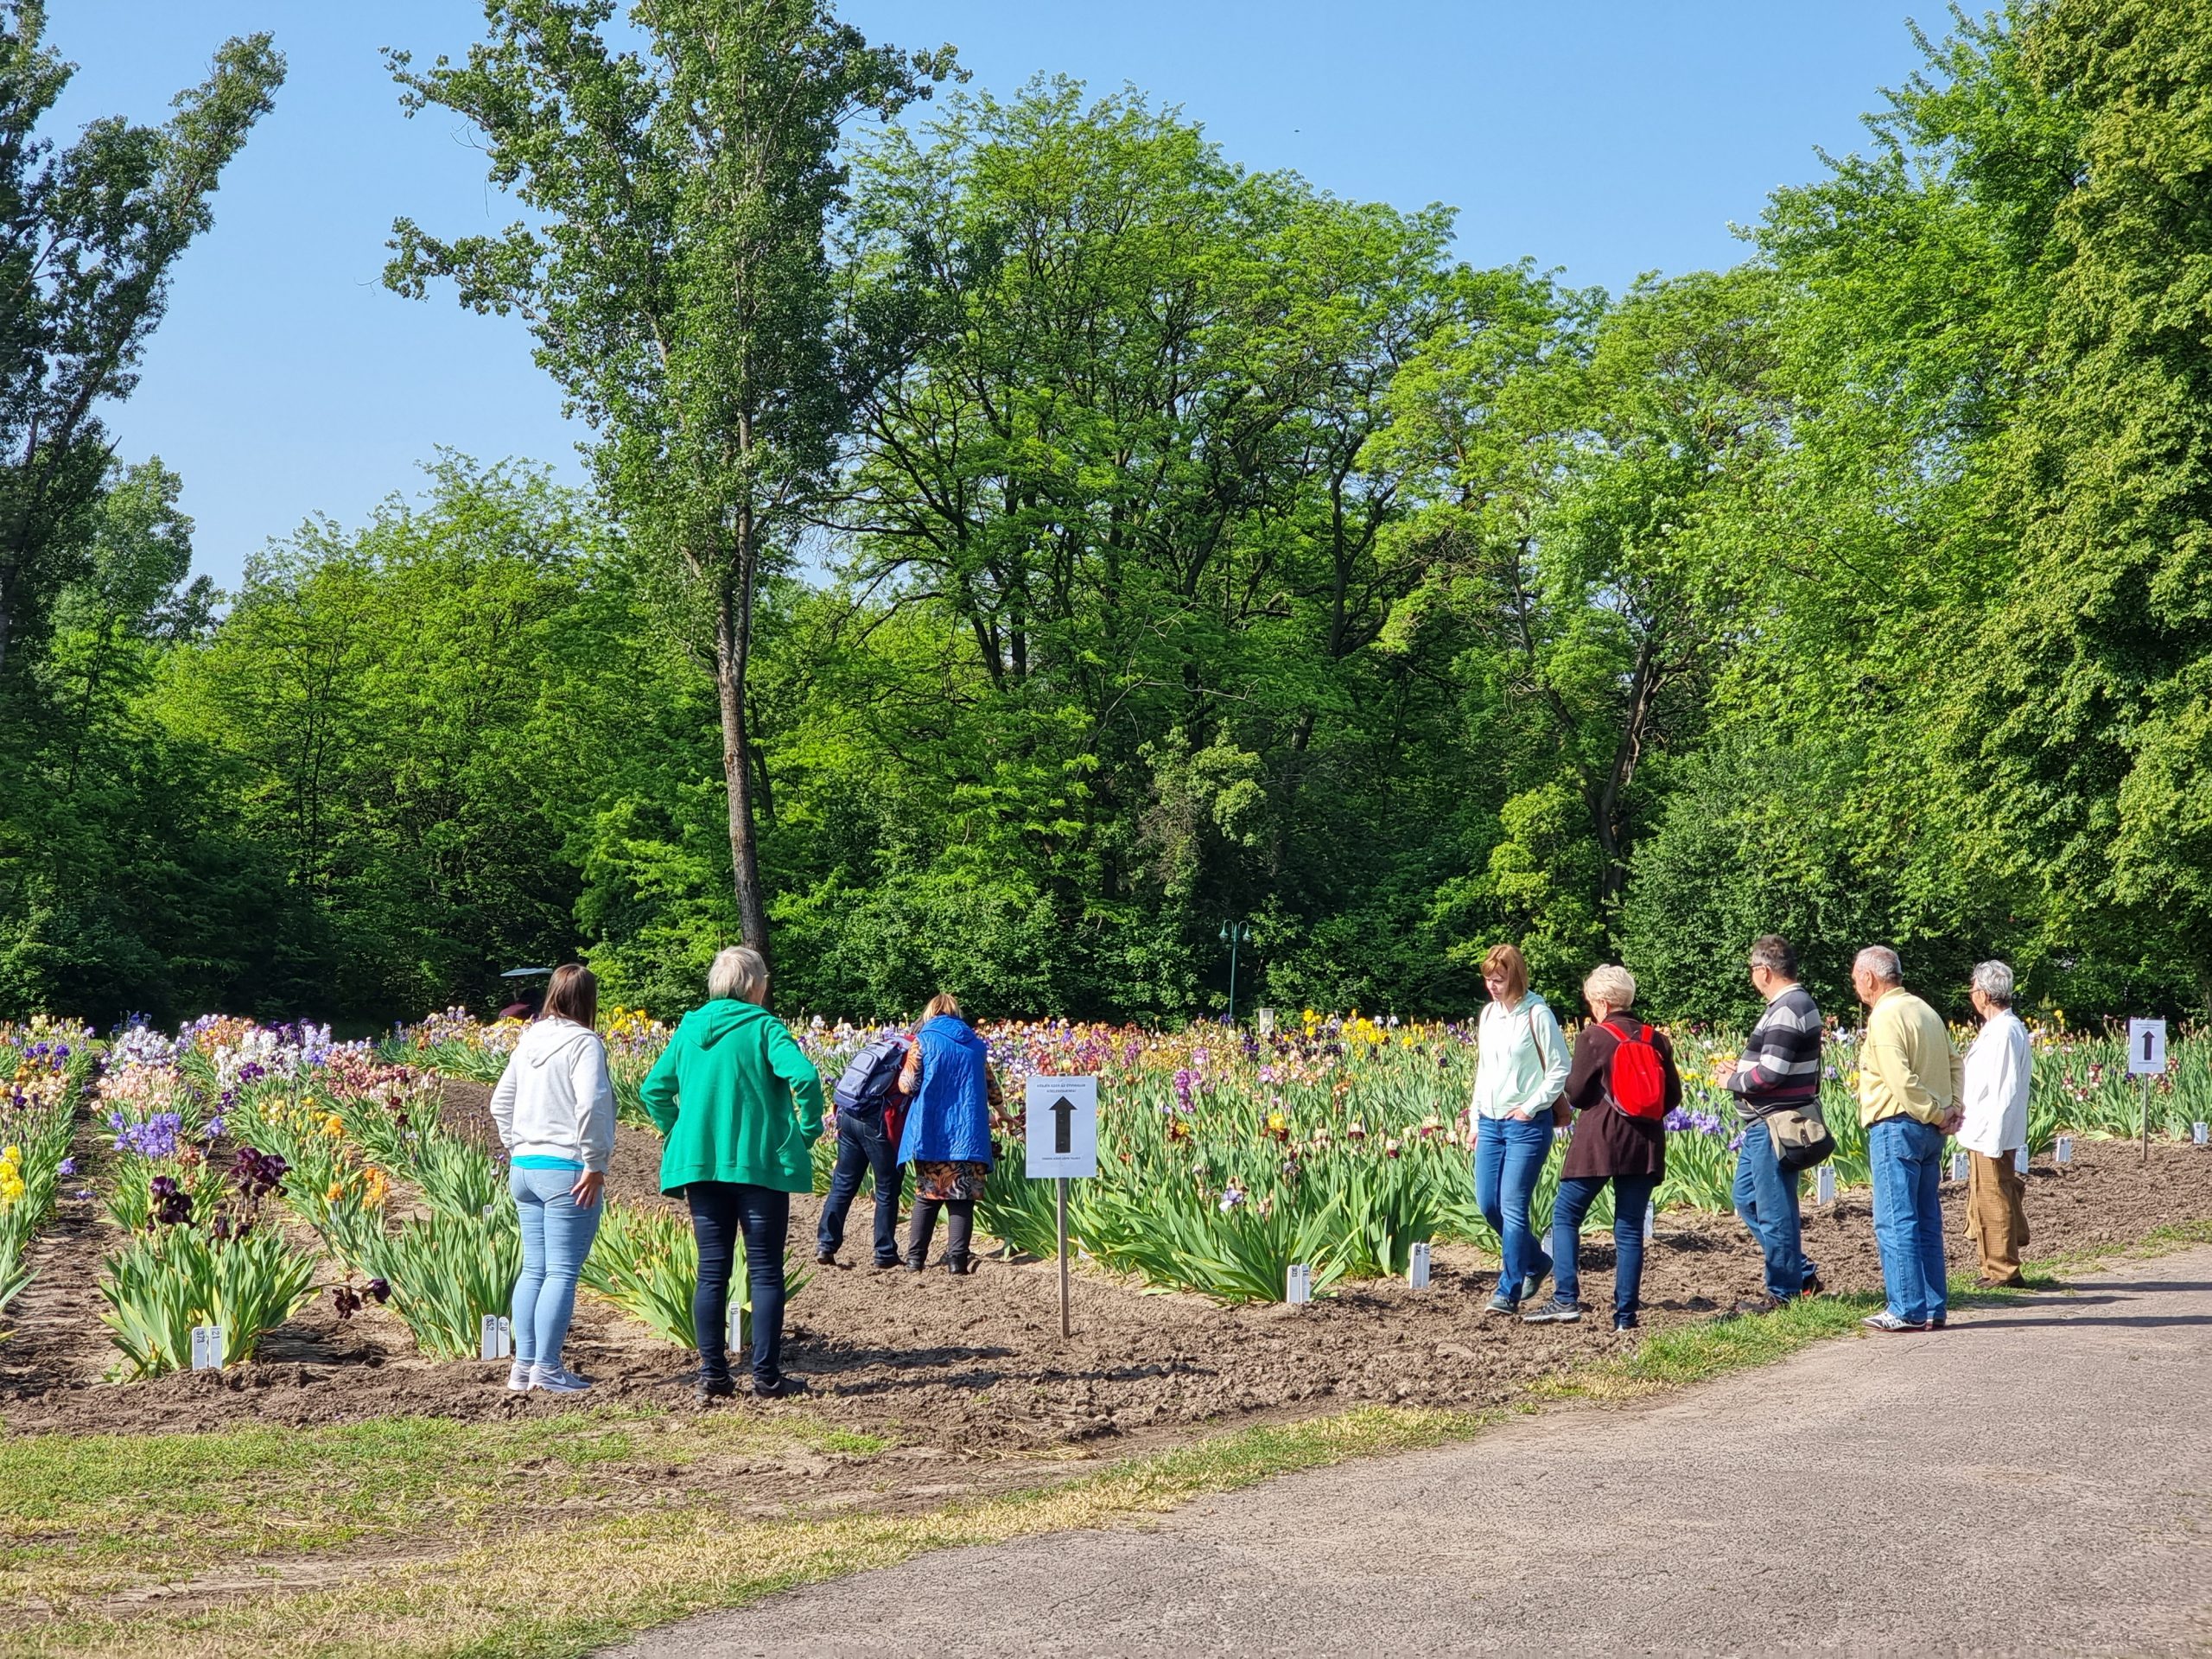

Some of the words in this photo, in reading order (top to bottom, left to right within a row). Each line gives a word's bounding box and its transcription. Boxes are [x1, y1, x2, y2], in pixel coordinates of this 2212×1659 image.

[486, 1318, 494, 1332] 352
[499, 1322, 508, 1332] 20
[196, 1331, 205, 1344] 373
[211, 1331, 220, 1339] 21
